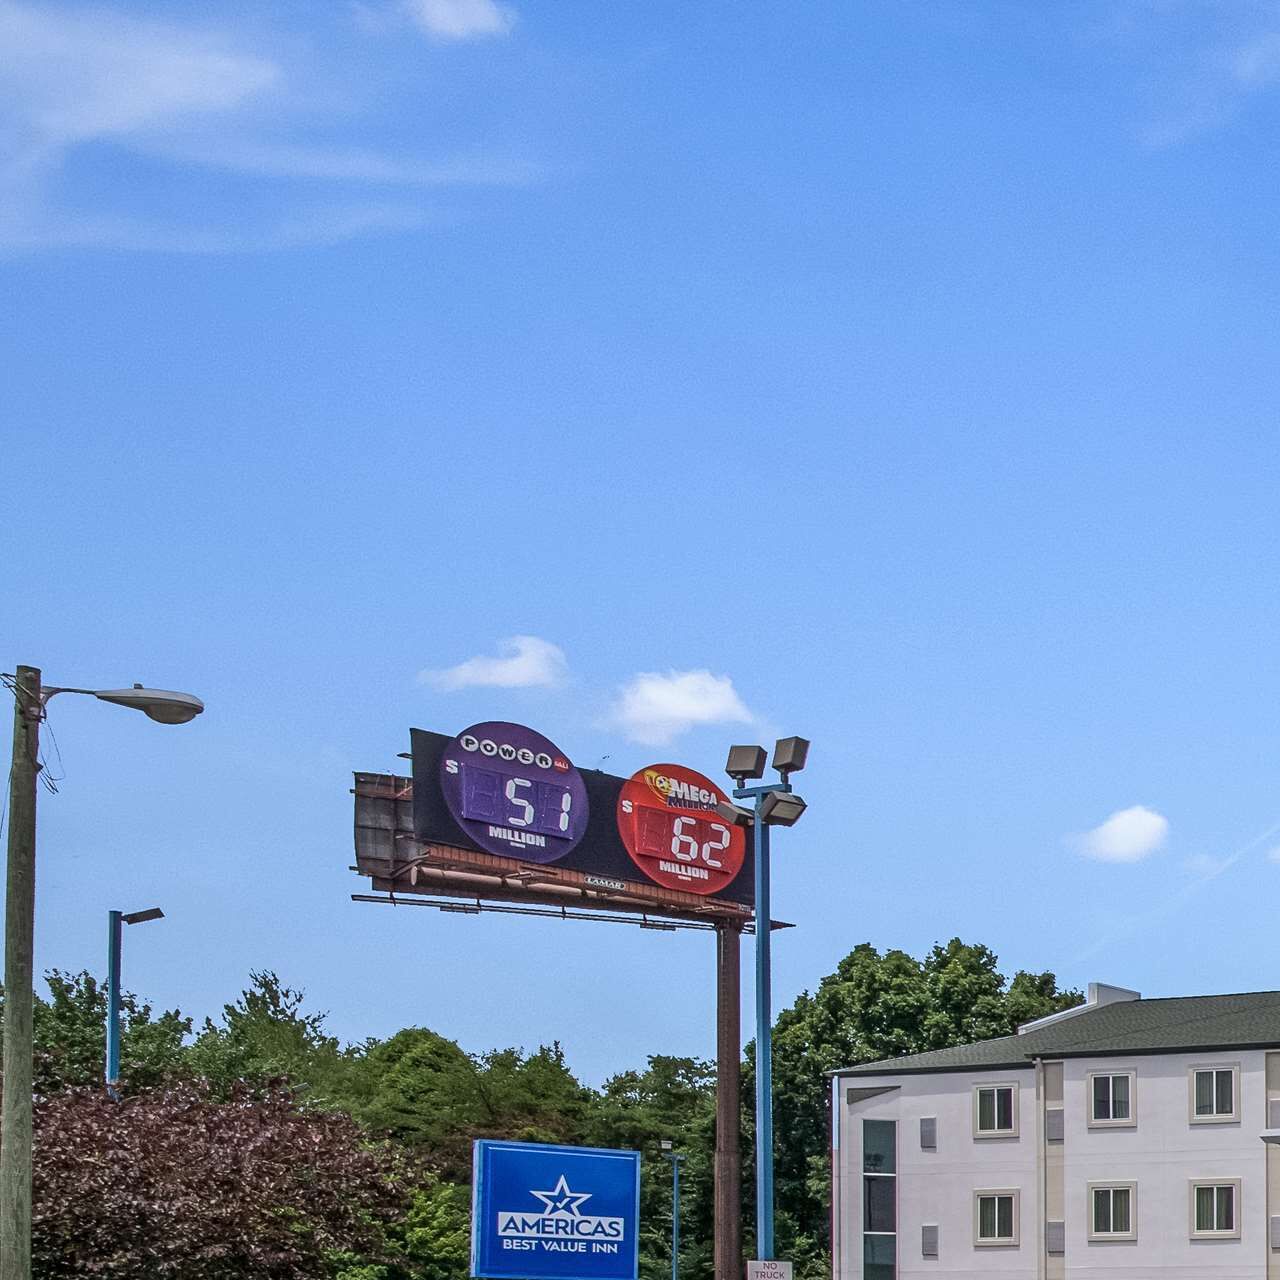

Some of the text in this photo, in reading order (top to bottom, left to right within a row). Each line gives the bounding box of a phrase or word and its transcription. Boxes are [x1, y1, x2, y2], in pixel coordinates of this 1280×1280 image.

[668, 777, 718, 805] MEGA
[505, 777, 572, 832] 51
[488, 825, 546, 848] MILLION
[671, 816, 731, 868] 62
[659, 860, 709, 880] MILLION
[587, 876, 622, 890] LAMAR
[501, 1215, 621, 1238] AMERICAS
[503, 1239, 618, 1254] BEST VALUE INN
[755, 1271, 785, 1279] TRUCK
[763, 1262, 778, 1270] NO
